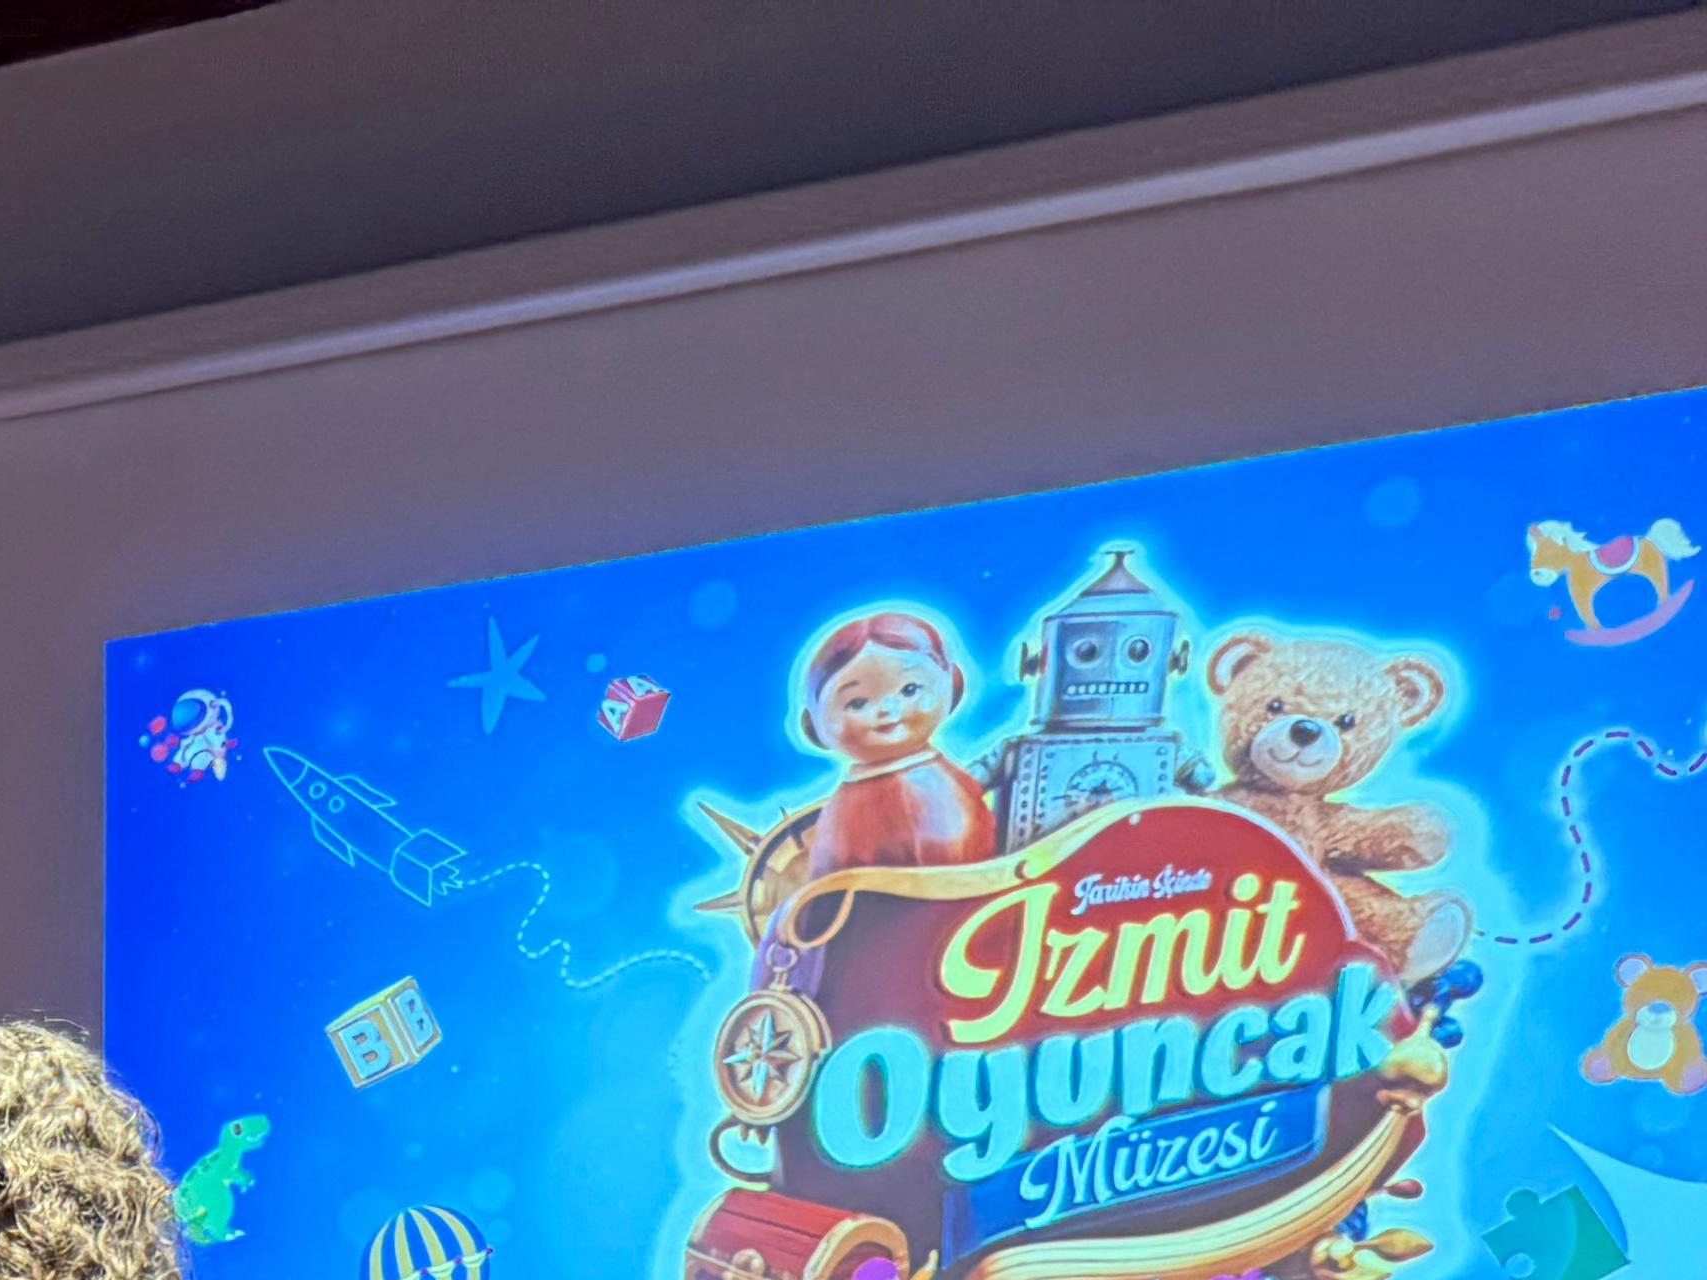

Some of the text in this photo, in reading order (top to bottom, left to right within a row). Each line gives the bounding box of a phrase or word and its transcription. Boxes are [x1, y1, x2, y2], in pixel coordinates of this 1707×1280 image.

[939, 862, 1307, 1042] İzmit
[338, 1019, 392, 1079] B
[811, 962, 1393, 1180] Oyuncak
[1019, 1102, 1279, 1228] Müzesi
